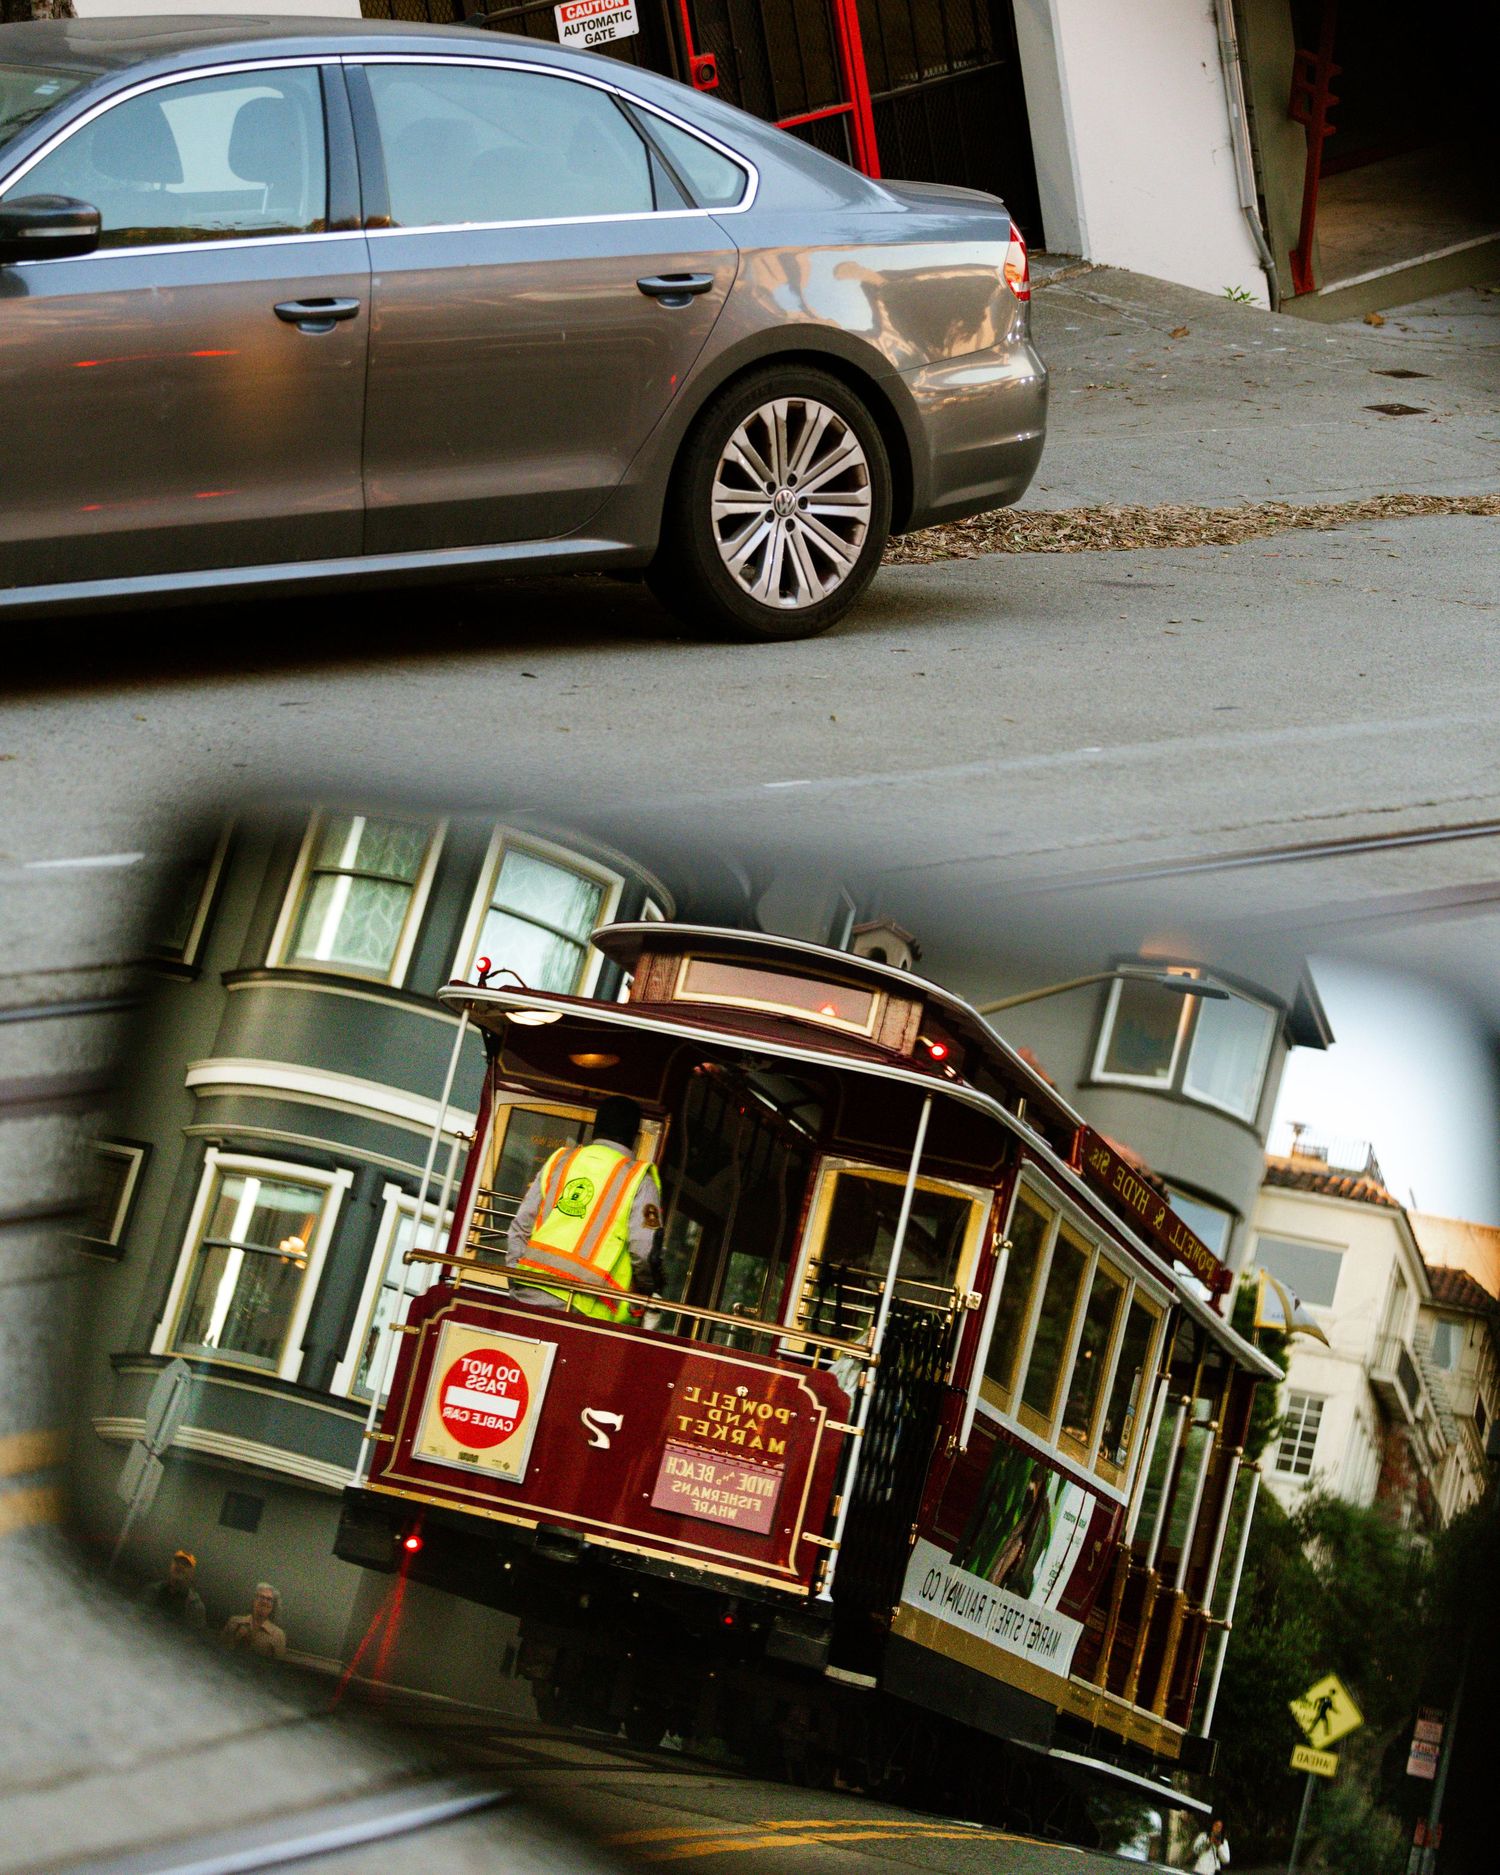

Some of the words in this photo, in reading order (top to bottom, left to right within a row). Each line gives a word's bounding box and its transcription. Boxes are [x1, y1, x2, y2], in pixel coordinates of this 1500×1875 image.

[566, 0, 624, 19] CAUTION
[564, 10, 632, 37] AUTOMATIC
[585, 27, 616, 44] GATE
